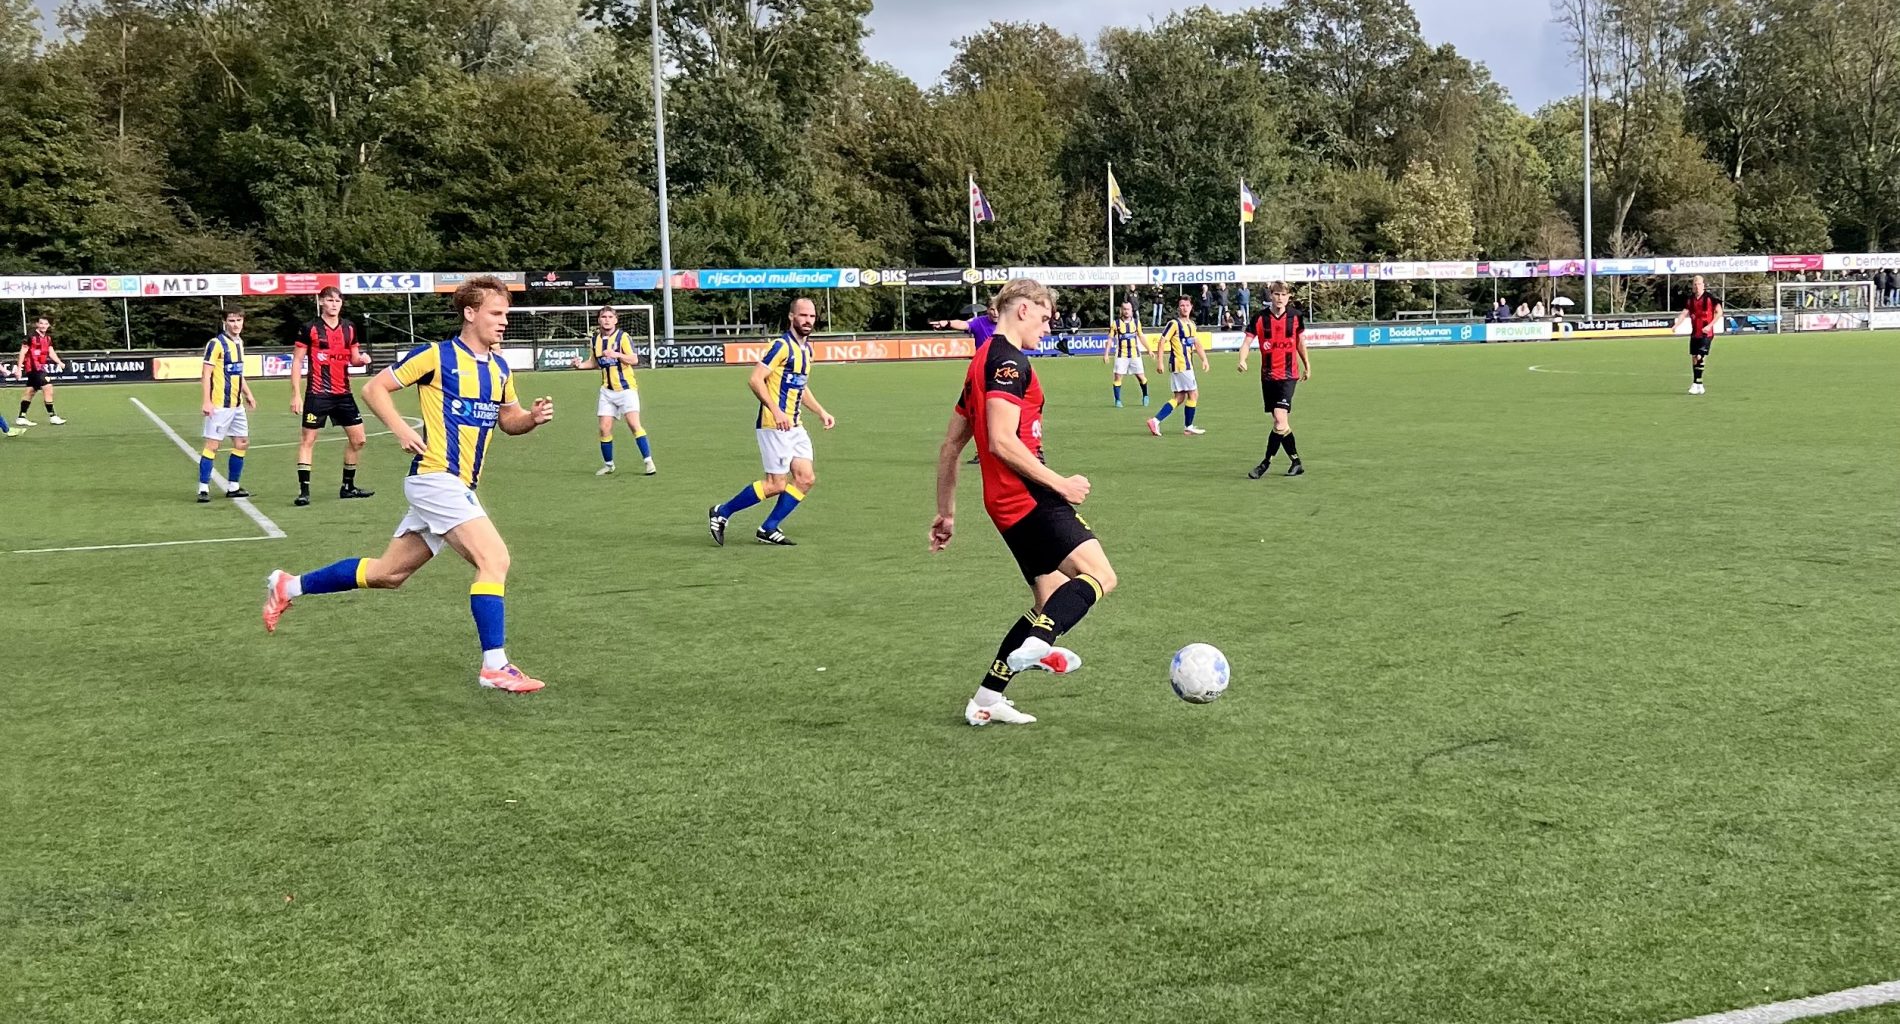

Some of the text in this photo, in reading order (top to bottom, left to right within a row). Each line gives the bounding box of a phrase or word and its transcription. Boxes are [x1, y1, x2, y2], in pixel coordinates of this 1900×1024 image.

[707, 271, 832, 286] rijschool mullender
[882, 270, 907, 282] BKS
[983, 269, 1009, 281] BKS
[1171, 269, 1236, 282] raadsma
[163, 279, 210, 291] MTD
[361, 275, 415, 289] V&G
[545, 348, 580, 360] Kapsel
[737, 348, 766, 362] IN
[825, 345, 862, 360] ING
[911, 343, 946, 357] ING
[87, 361, 145, 372] LANTAARN
